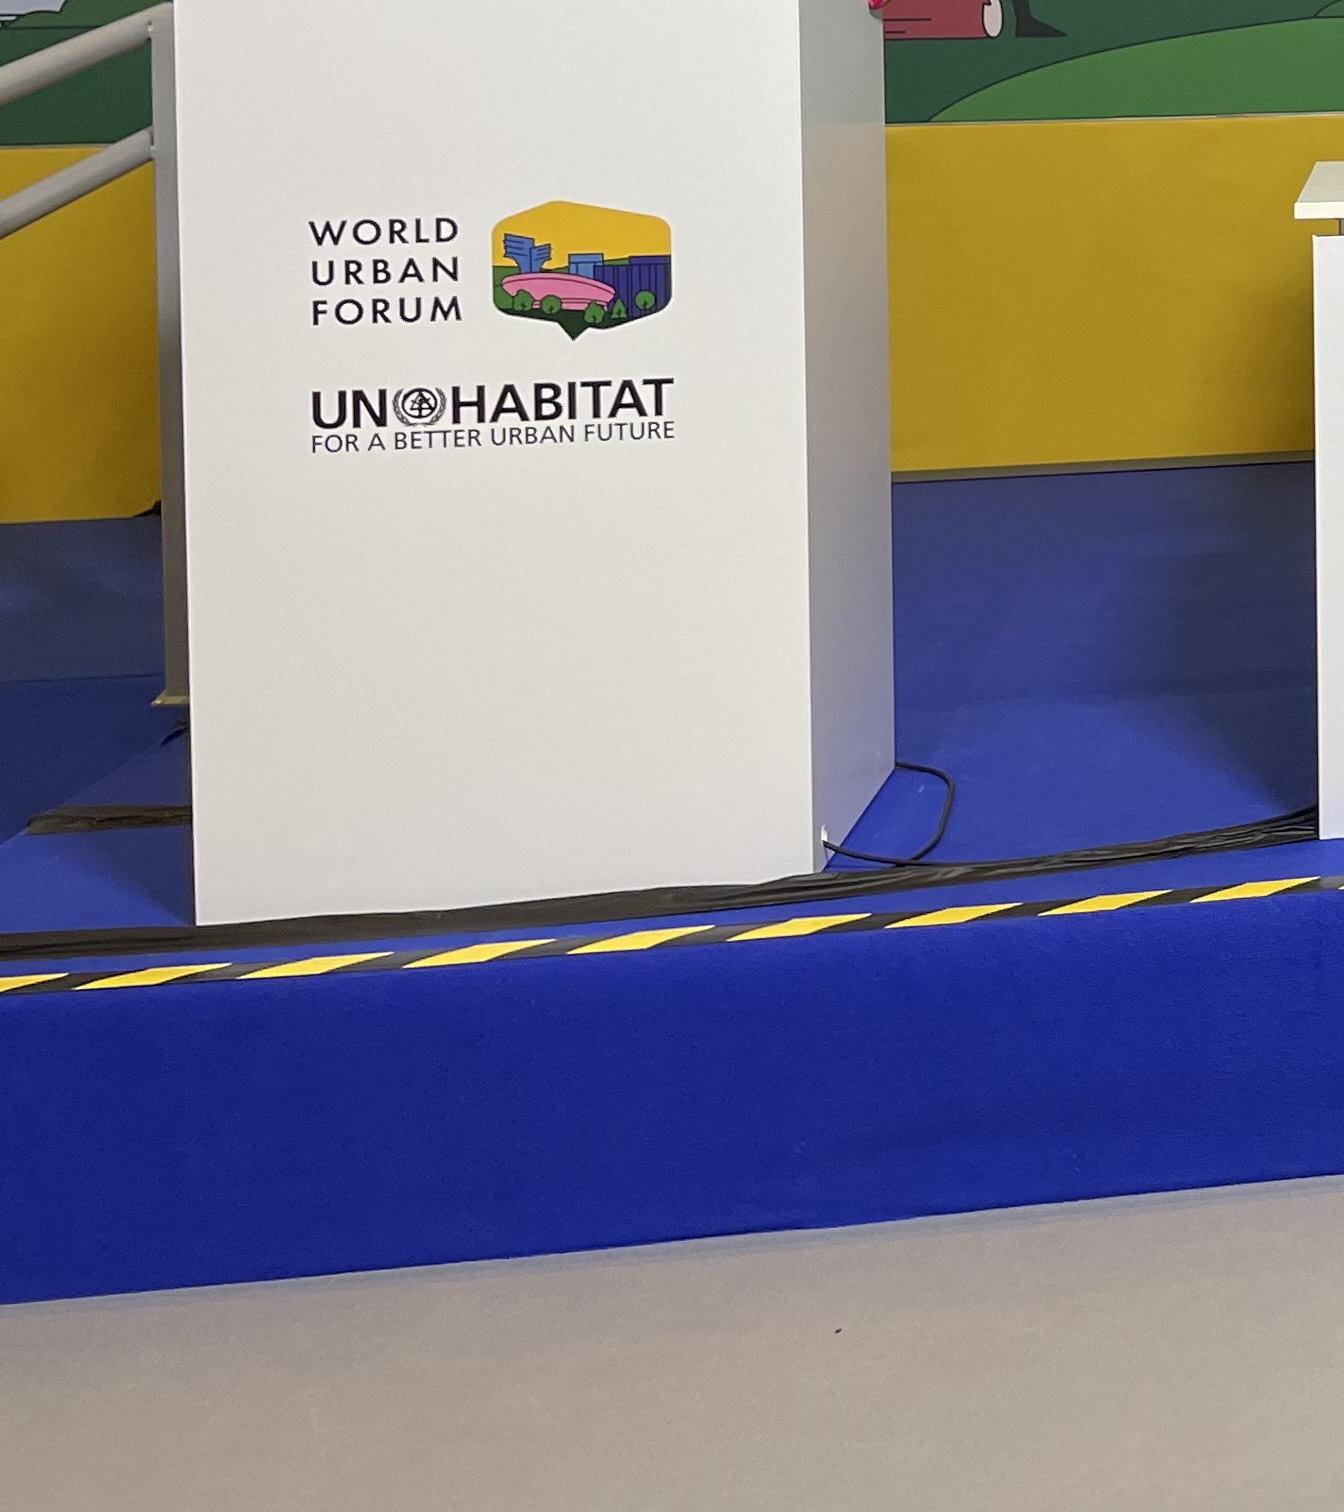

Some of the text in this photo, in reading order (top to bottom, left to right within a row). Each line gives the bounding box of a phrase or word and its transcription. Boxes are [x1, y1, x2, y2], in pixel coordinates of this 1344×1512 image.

[308, 217, 458, 247] WORLD
[311, 256, 458, 286] URBAN
[312, 295, 462, 326] FORUM
[311, 377, 675, 430] UN HABITAT
[311, 420, 675, 454] FOR A BETTER URBAN FUTURE
